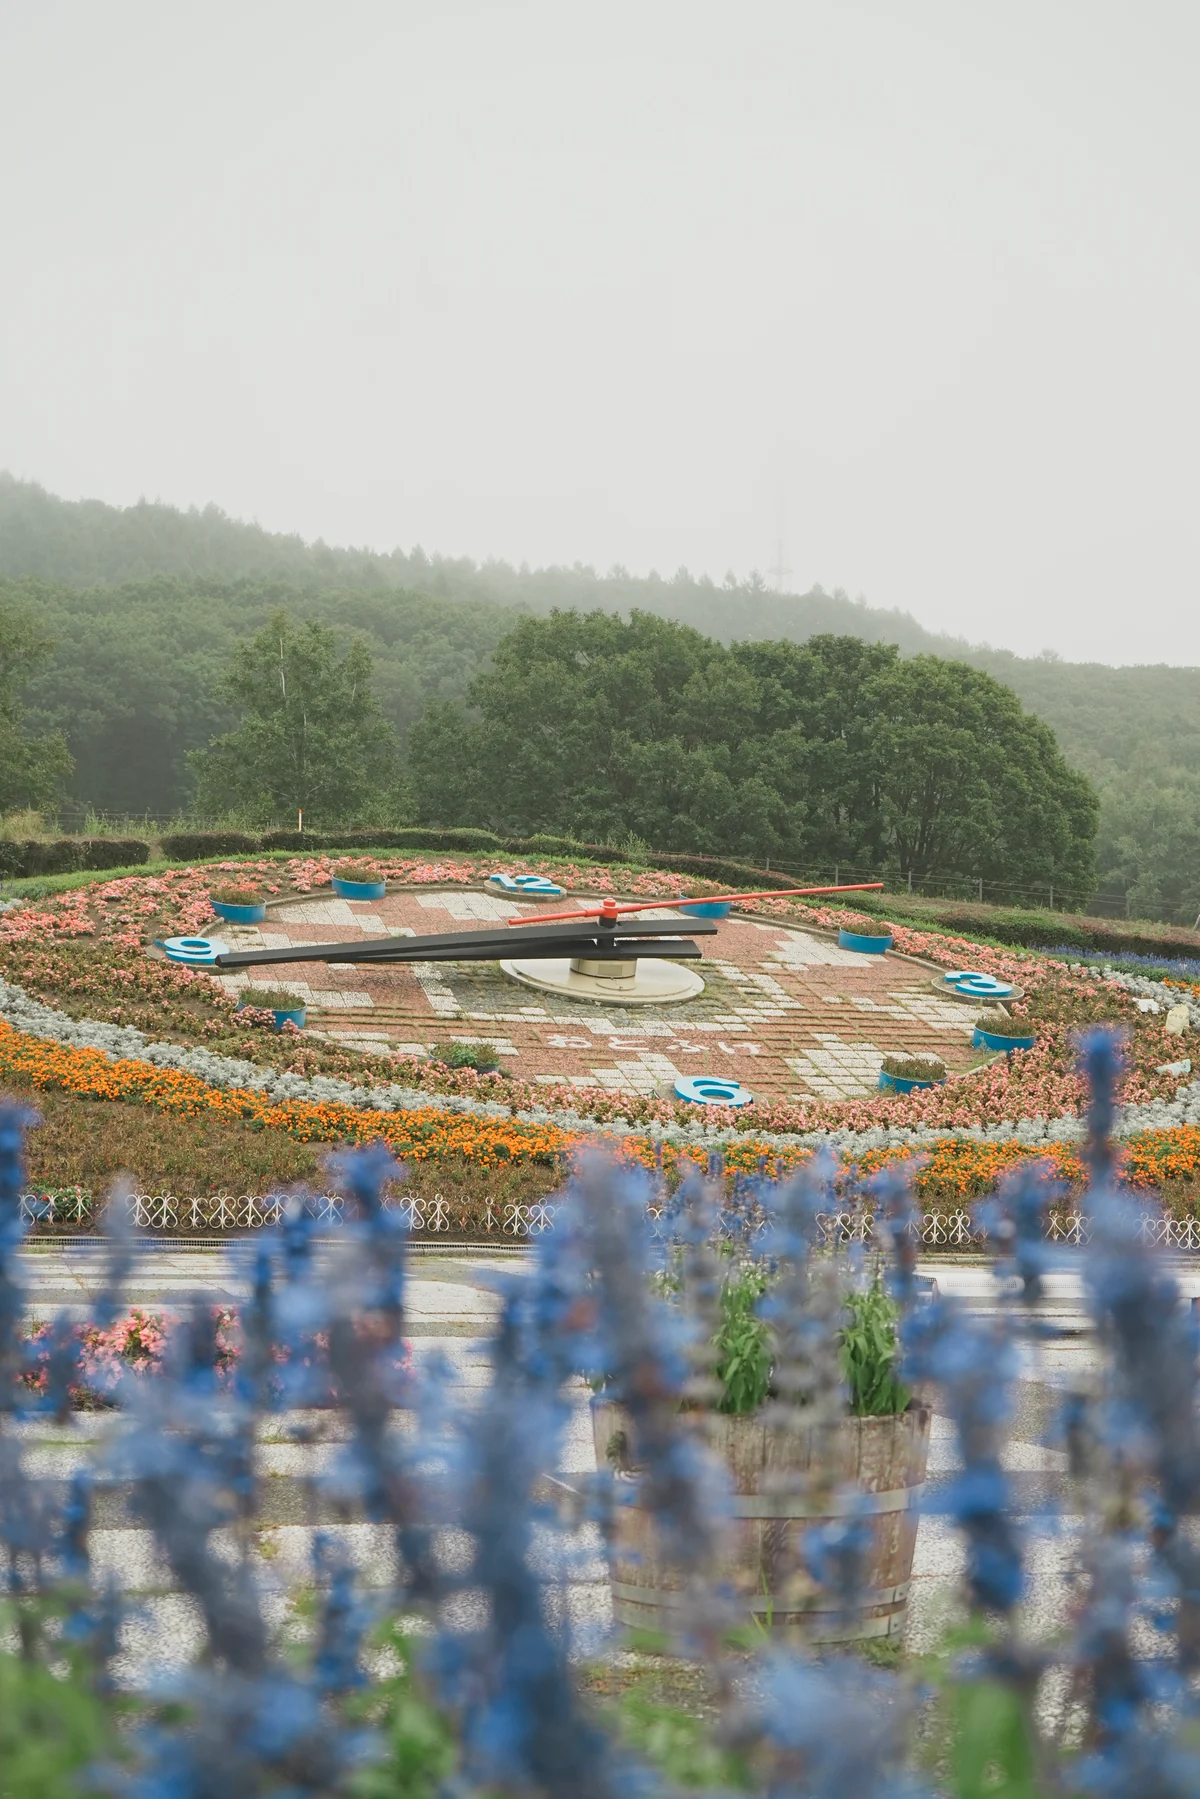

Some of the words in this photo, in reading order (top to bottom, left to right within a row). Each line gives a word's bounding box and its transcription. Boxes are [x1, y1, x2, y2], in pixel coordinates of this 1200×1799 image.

[490, 874, 561, 894] 12
[163, 936, 230, 964] 9
[945, 971, 1012, 996] 3
[546, 1034, 762, 1054] おとふけ
[674, 1076, 753, 1107] 6
